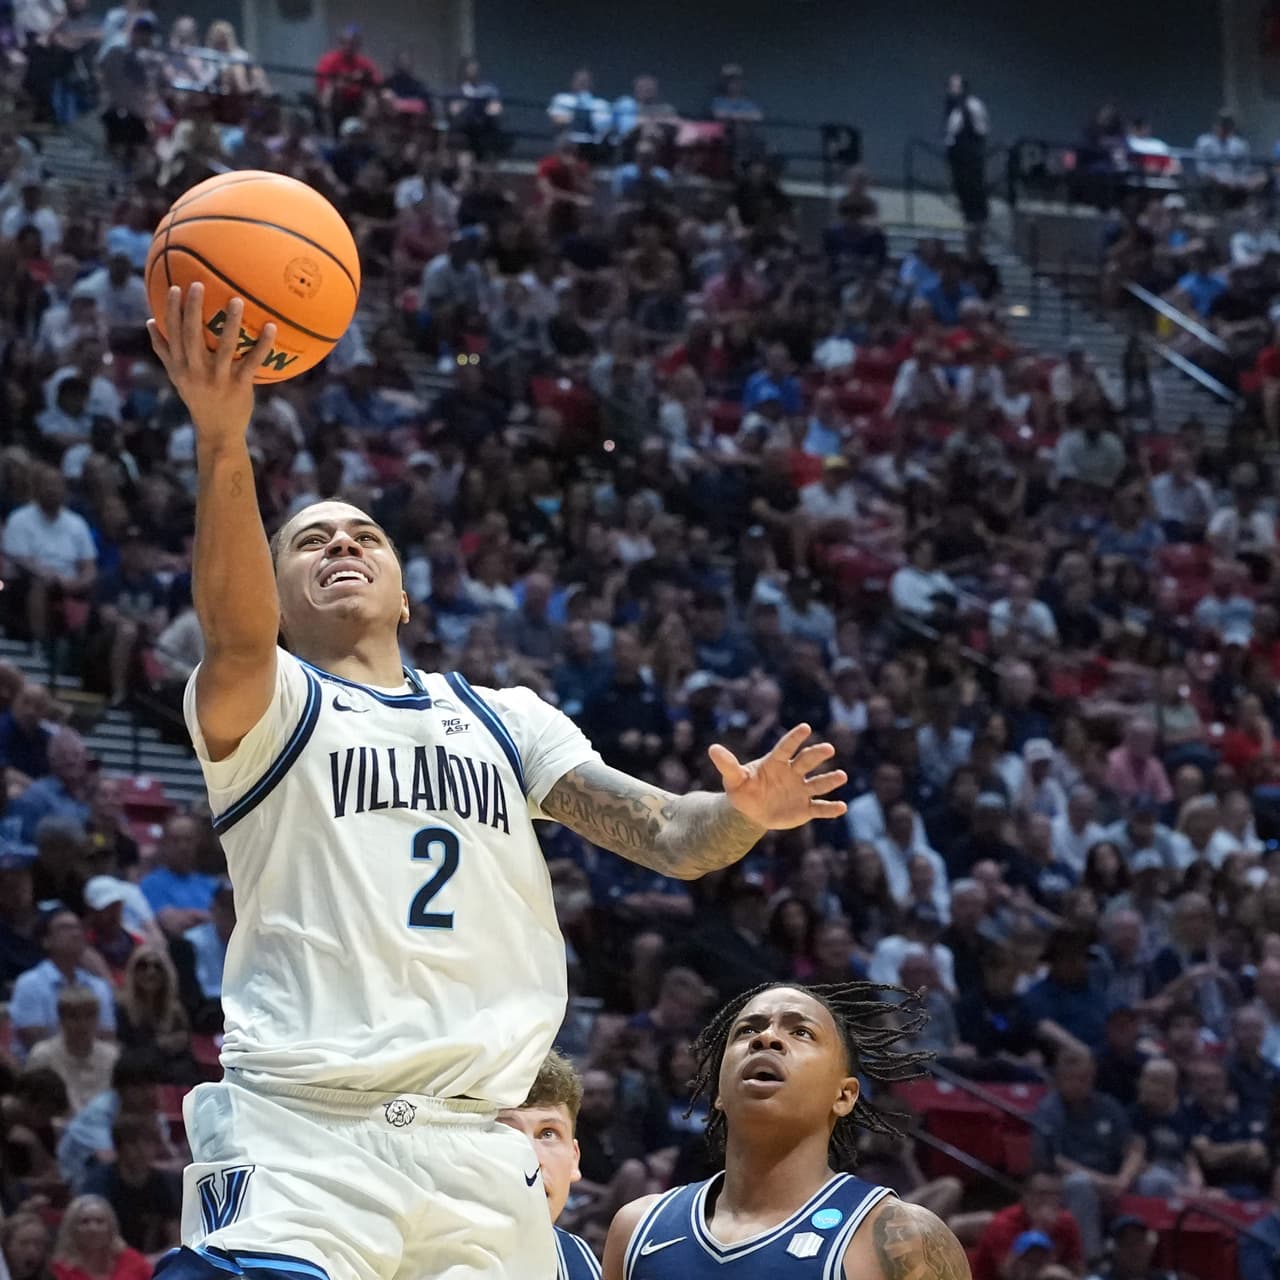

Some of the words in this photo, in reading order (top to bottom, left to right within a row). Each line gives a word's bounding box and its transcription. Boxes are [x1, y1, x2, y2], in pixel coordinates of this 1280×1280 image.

[329, 745, 510, 835] VILLANOVA
[407, 824, 461, 930] 2
[196, 1164, 255, 1237] V
